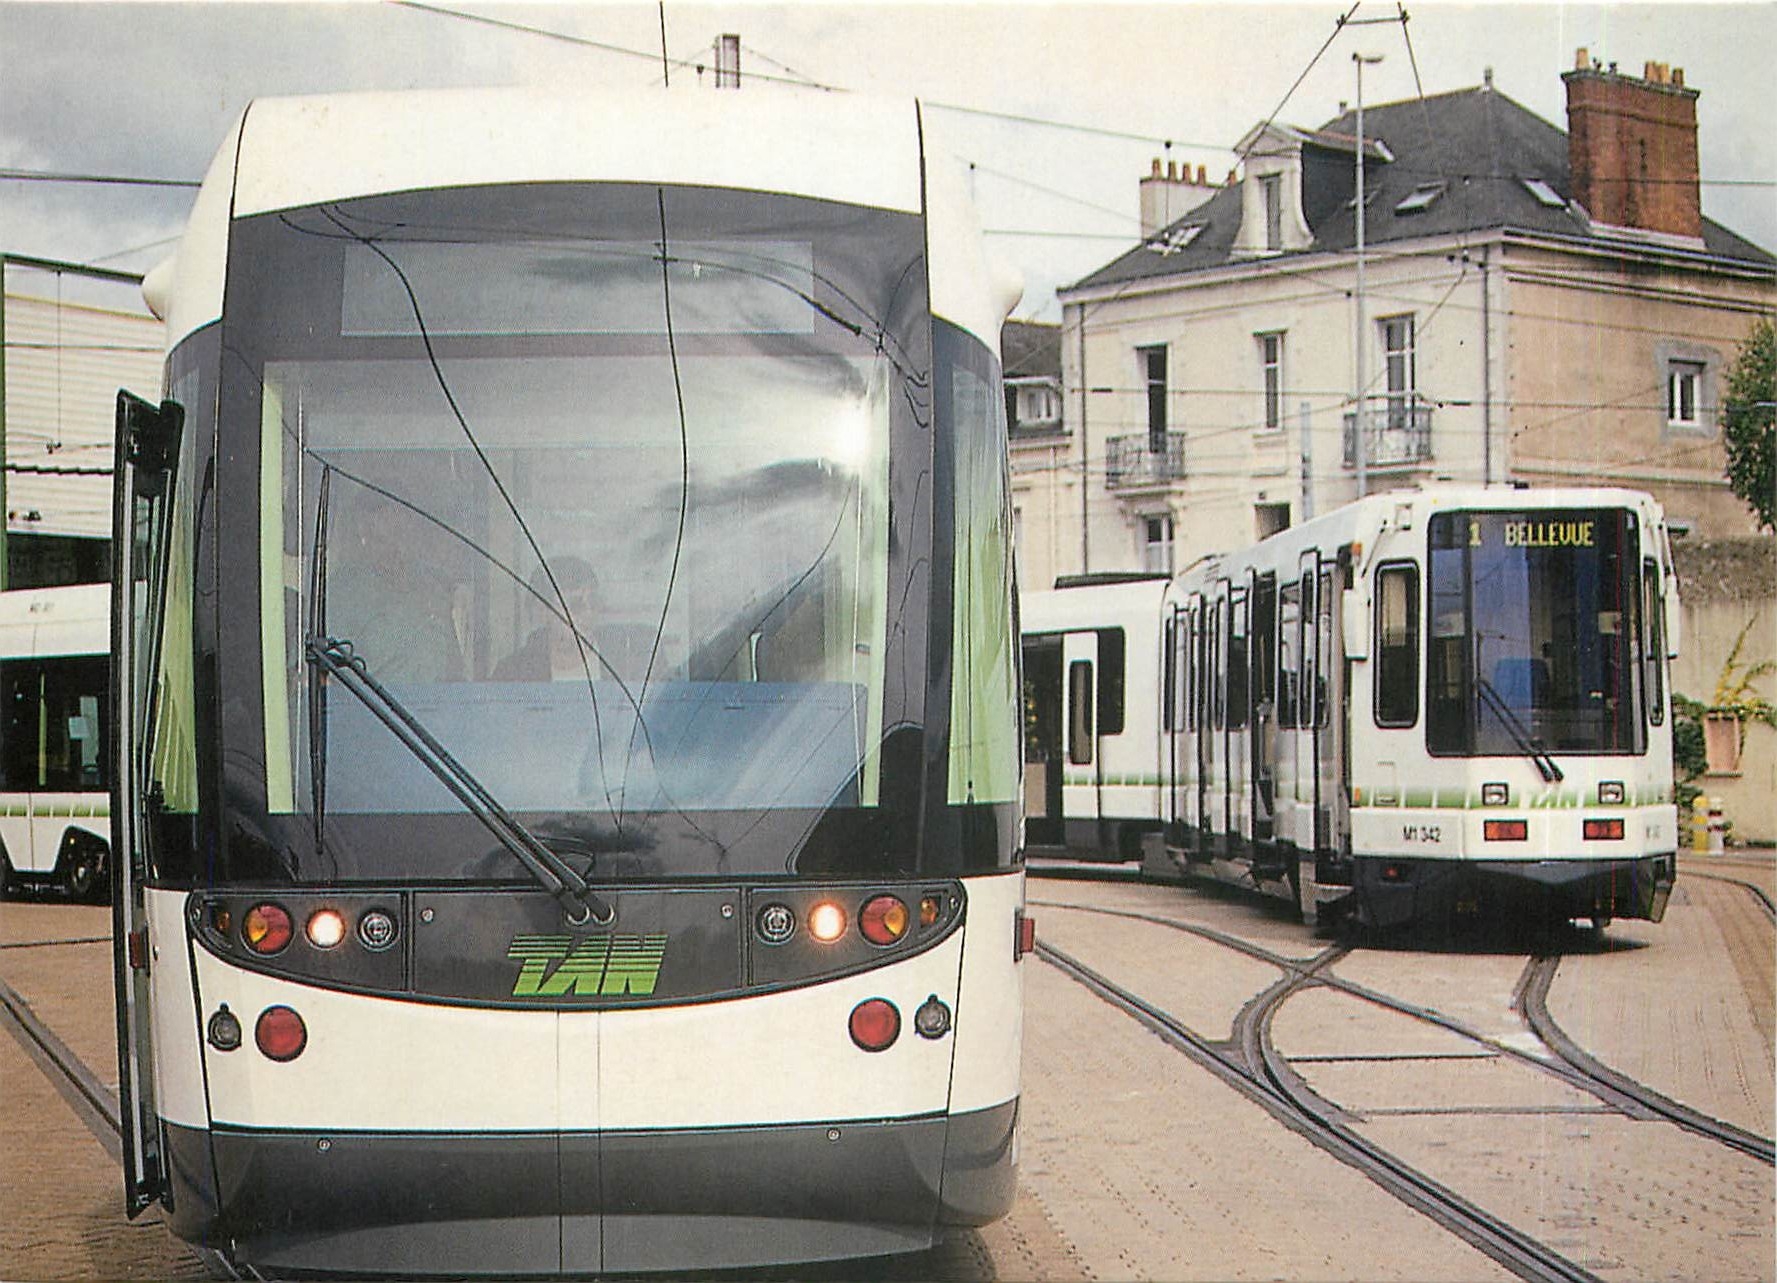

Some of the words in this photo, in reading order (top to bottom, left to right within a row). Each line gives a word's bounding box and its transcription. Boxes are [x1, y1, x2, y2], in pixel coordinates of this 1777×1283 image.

[1468, 521, 1481, 545] 1
[1505, 521, 1594, 546] BELLEVUE
[507, 934, 668, 997] TAN
